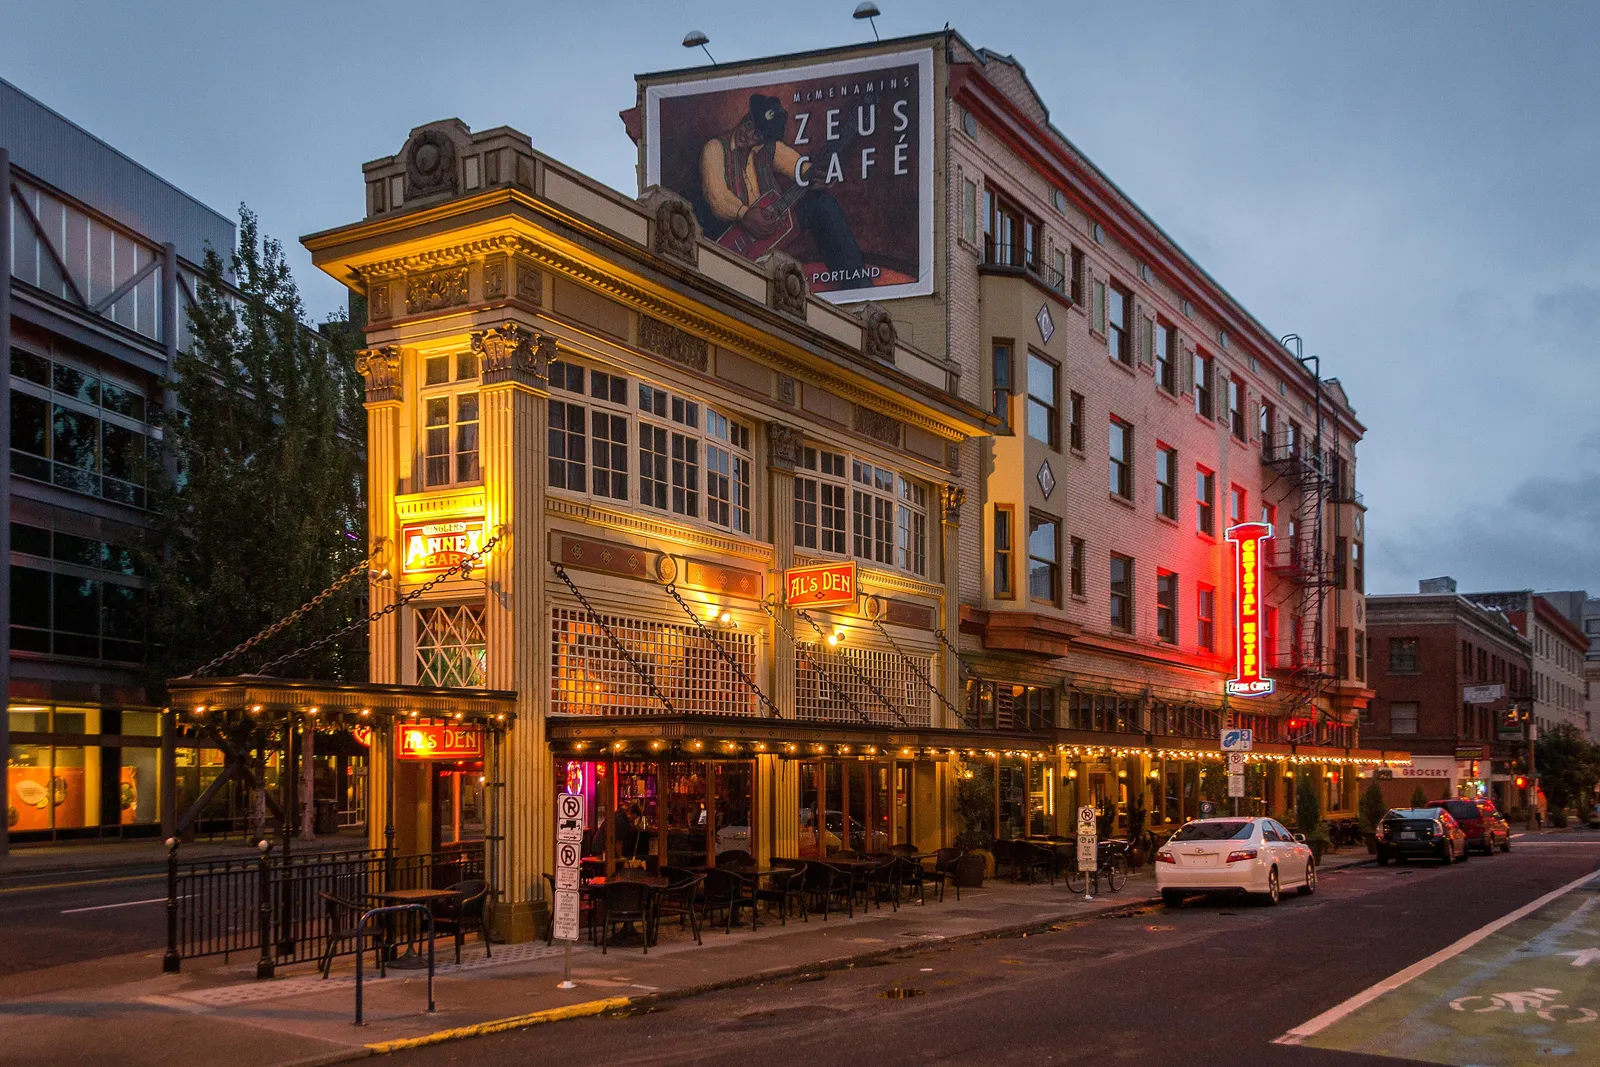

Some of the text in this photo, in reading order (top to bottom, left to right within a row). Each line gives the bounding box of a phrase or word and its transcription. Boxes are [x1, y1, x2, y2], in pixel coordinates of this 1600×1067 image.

[793, 77, 909, 102] McMENAMINS
[794, 99, 908, 145] ZEUS
[795, 133, 908, 187] CAFÉ
[812, 266, 880, 283] PORTLAND
[405, 530, 482, 566] ANNEX
[425, 553, 461, 566] BAR
[822, 571, 851, 593] DEN
[1242, 622, 1257, 676] HOTEL
[443, 729, 476, 748] DEN
[1402, 768, 1449, 777] GROCERY
